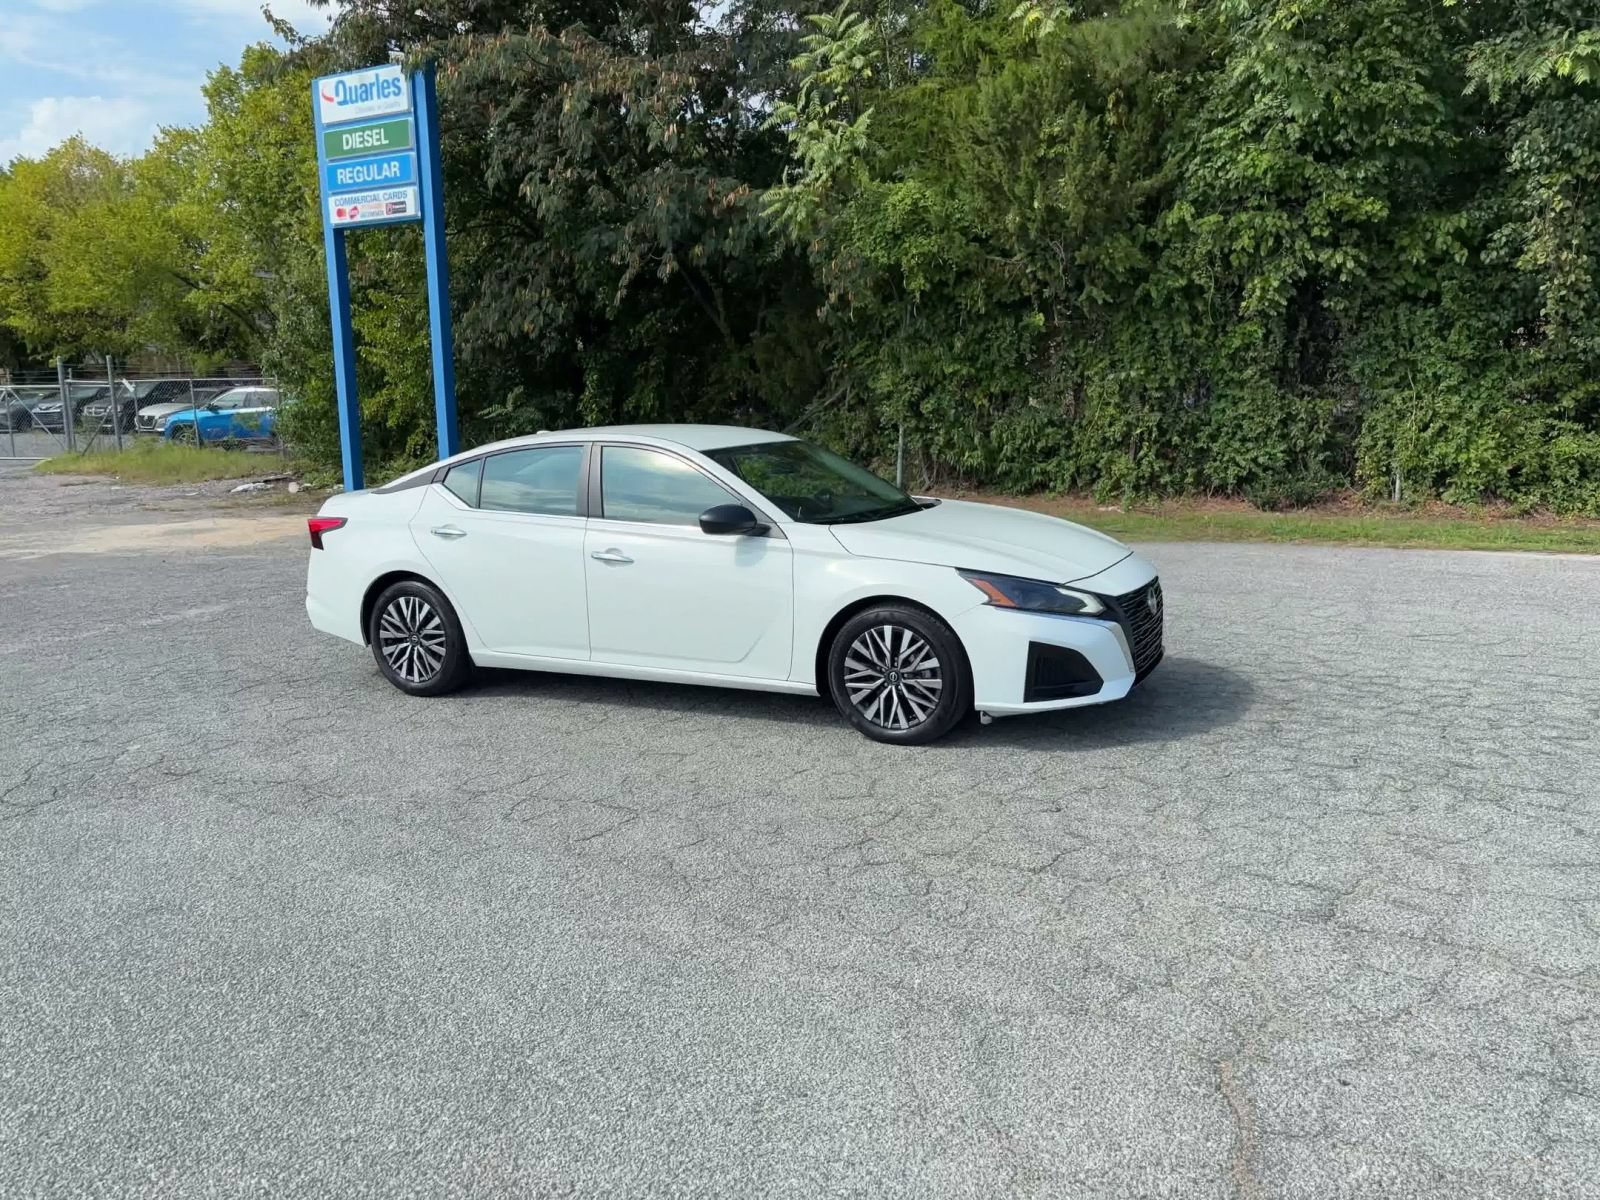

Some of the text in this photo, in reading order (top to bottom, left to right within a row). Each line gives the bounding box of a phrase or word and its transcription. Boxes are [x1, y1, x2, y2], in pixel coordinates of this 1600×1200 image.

[335, 73, 402, 106] Quarles
[342, 128, 389, 150] DIESEL
[337, 161, 400, 185] REGULAR
[334, 190, 408, 206] COMMERCIAL CARDS
